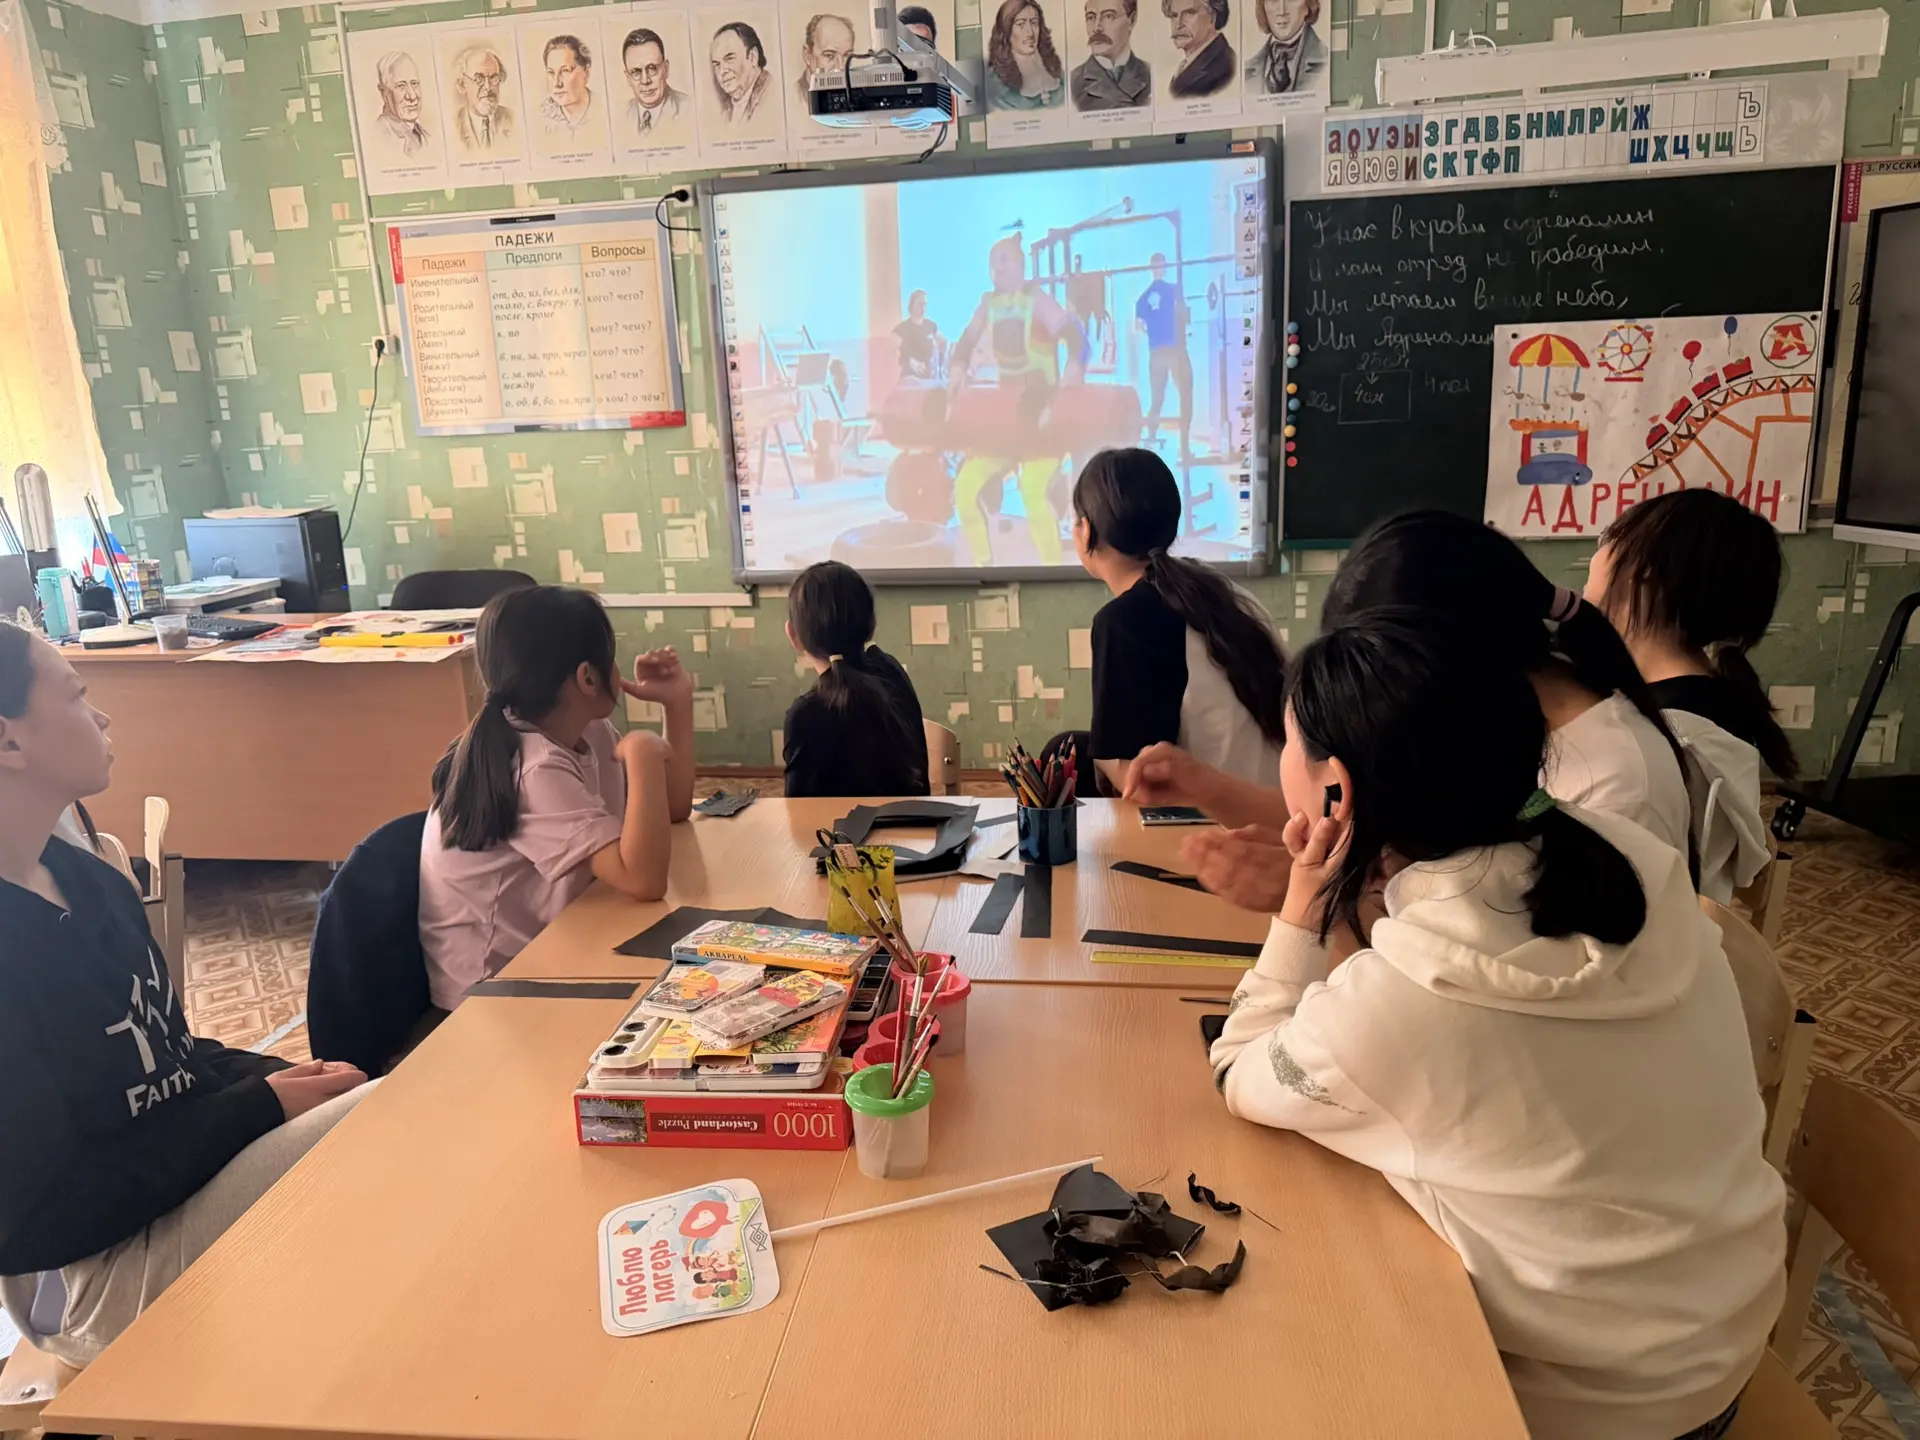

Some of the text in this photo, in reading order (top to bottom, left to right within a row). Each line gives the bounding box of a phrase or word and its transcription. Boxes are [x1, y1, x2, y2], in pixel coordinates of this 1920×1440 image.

[1305, 205, 1332, 248] У
[1503, 209, 1654, 246] адреналин
[495, 232, 555, 247] ПАДЕЖИ
[422, 245, 646, 271] Падежи Предлоги Вопросы
[410, 266, 632, 288] Именительный кто? что?
[1397, 253, 1467, 284] отряд
[587, 290, 644, 302] кого? чего?
[1306, 289, 1349, 316] Мы
[1366, 290, 1457, 313] летаем
[413, 301, 474, 313] Родительный
[416, 327, 466, 340] Дательный
[590, 322, 619, 335] кому?
[622, 320, 652, 333] чему?
[1308, 317, 1357, 351] Мы
[419, 349, 480, 361] Винительный
[592, 345, 644, 357] кого? что?
[422, 372, 487, 383] Творительный
[594, 369, 644, 380] кем? чем?
[425, 395, 484, 407] Предложный
[606, 393, 629, 403] ком?
[1521, 480, 1782, 532] АДРЕИН
[703, 950, 749, 962] АКВАРЕЛЬ
[658, 1119, 758, 1131] Castorland Puzzle
[773, 1112, 837, 1138] 1000
[649, 1239, 677, 1303] лагерь
[616, 1246, 648, 1316] Люблю
